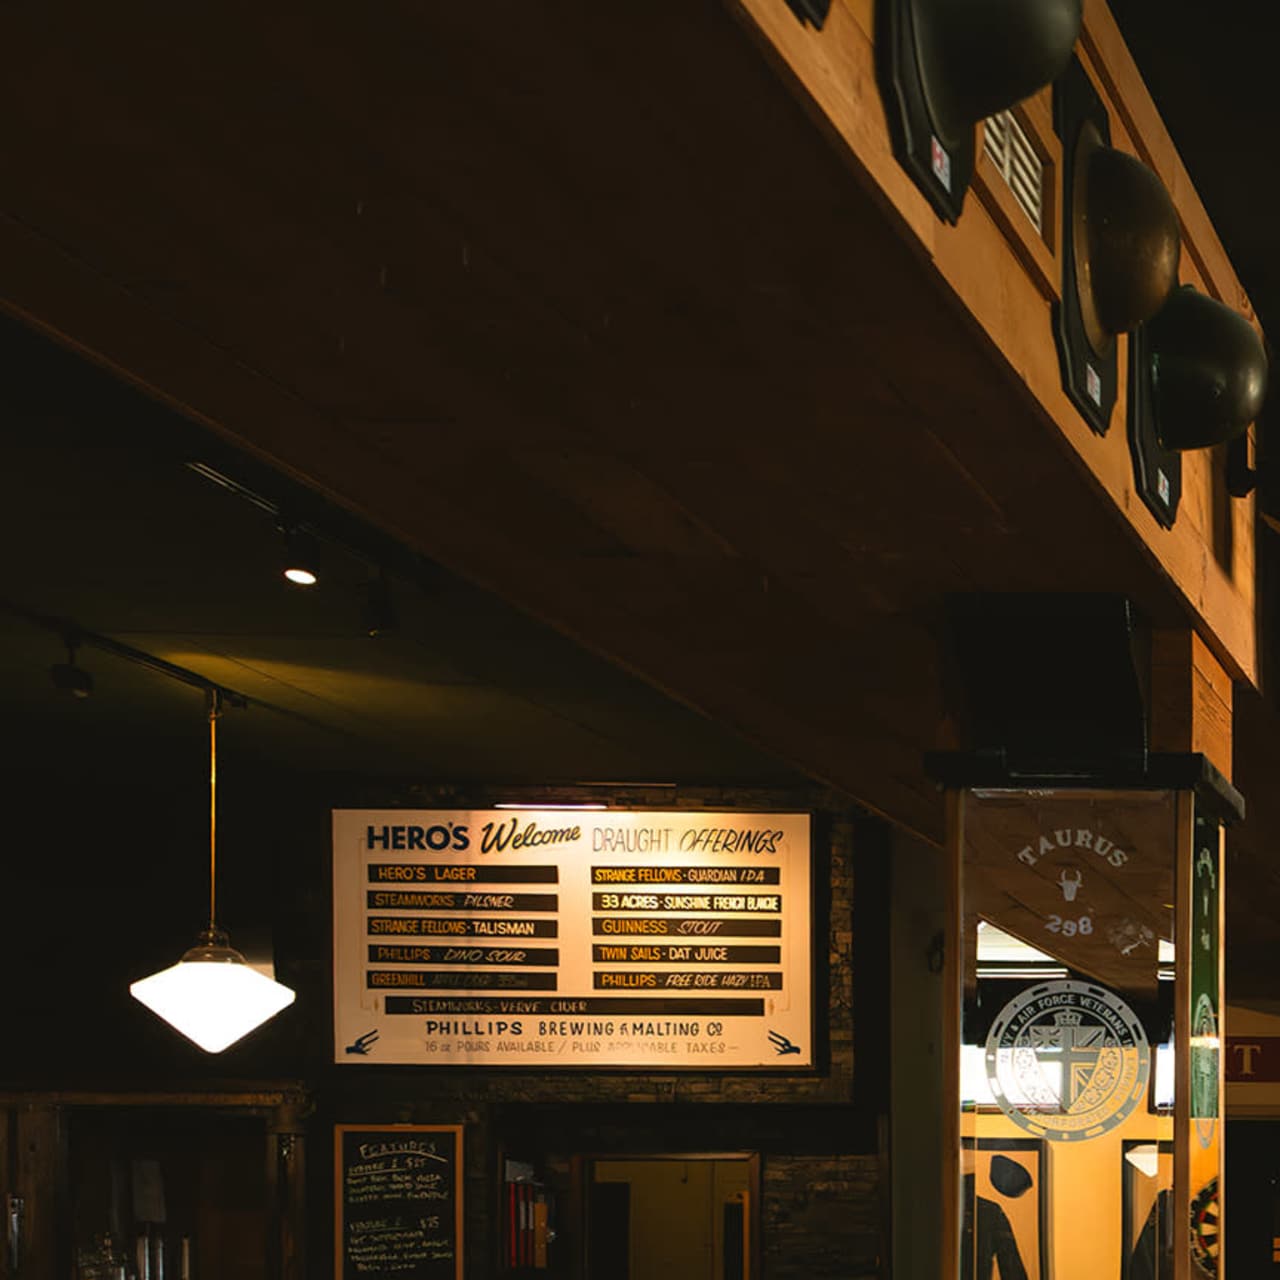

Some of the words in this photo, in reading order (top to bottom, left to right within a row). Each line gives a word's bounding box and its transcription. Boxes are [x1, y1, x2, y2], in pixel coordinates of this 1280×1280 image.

[367, 822, 470, 850] HERO'S
[480, 817, 581, 853] Welcome
[592, 827, 672, 852] DRAUGHT
[680, 828, 784, 854] OFFERINGS
[1017, 829, 1128, 867] TAURUS
[378, 867, 427, 880] HERO'S
[434, 868, 477, 881] LAGER
[594, 869, 636, 881] STRANGE
[638, 869, 683, 881] FELLOWS
[687, 869, 737, 882] GUARDIAN
[374, 893, 456, 906] STEAMWORKS
[463, 894, 515, 909] PILSNER
[601, 894, 620, 908] 33
[620, 895, 660, 909] ACRES
[371, 920, 419, 934] STRANGE
[421, 920, 467, 934] FELLOWS
[472, 921, 535, 935] TALISMAN
[601, 920, 669, 934] GUINNESS
[676, 921, 724, 935] STOUT
[1043, 913, 1094, 937] 298
[377, 947, 432, 960] PHILLIPS
[443, 948, 484, 962] DINO
[485, 950, 527, 963] SOUR
[600, 947, 627, 961] TWIN
[630, 947, 662, 961] SAILS
[668, 947, 692, 961] DAT
[694, 947, 728, 961] JUICE
[601, 974, 657, 987] PHILLIPS
[1016, 1005, 1037, 1026] AIR
[1038, 994, 1076, 1010] FORCE
[1080, 996, 1127, 1035] VETERANS
[426, 1021, 523, 1035] PHILLIPS
[538, 1022, 614, 1036] BREWING
[632, 1022, 700, 1036] MALTING
[456, 1041, 491, 1052] POURS
[496, 1041, 555, 1053] AVAILABLE
[571, 1041, 601, 1053] PLUS
[686, 1042, 726, 1054] TAXES
[1227, 1044, 1262, 1075] T
